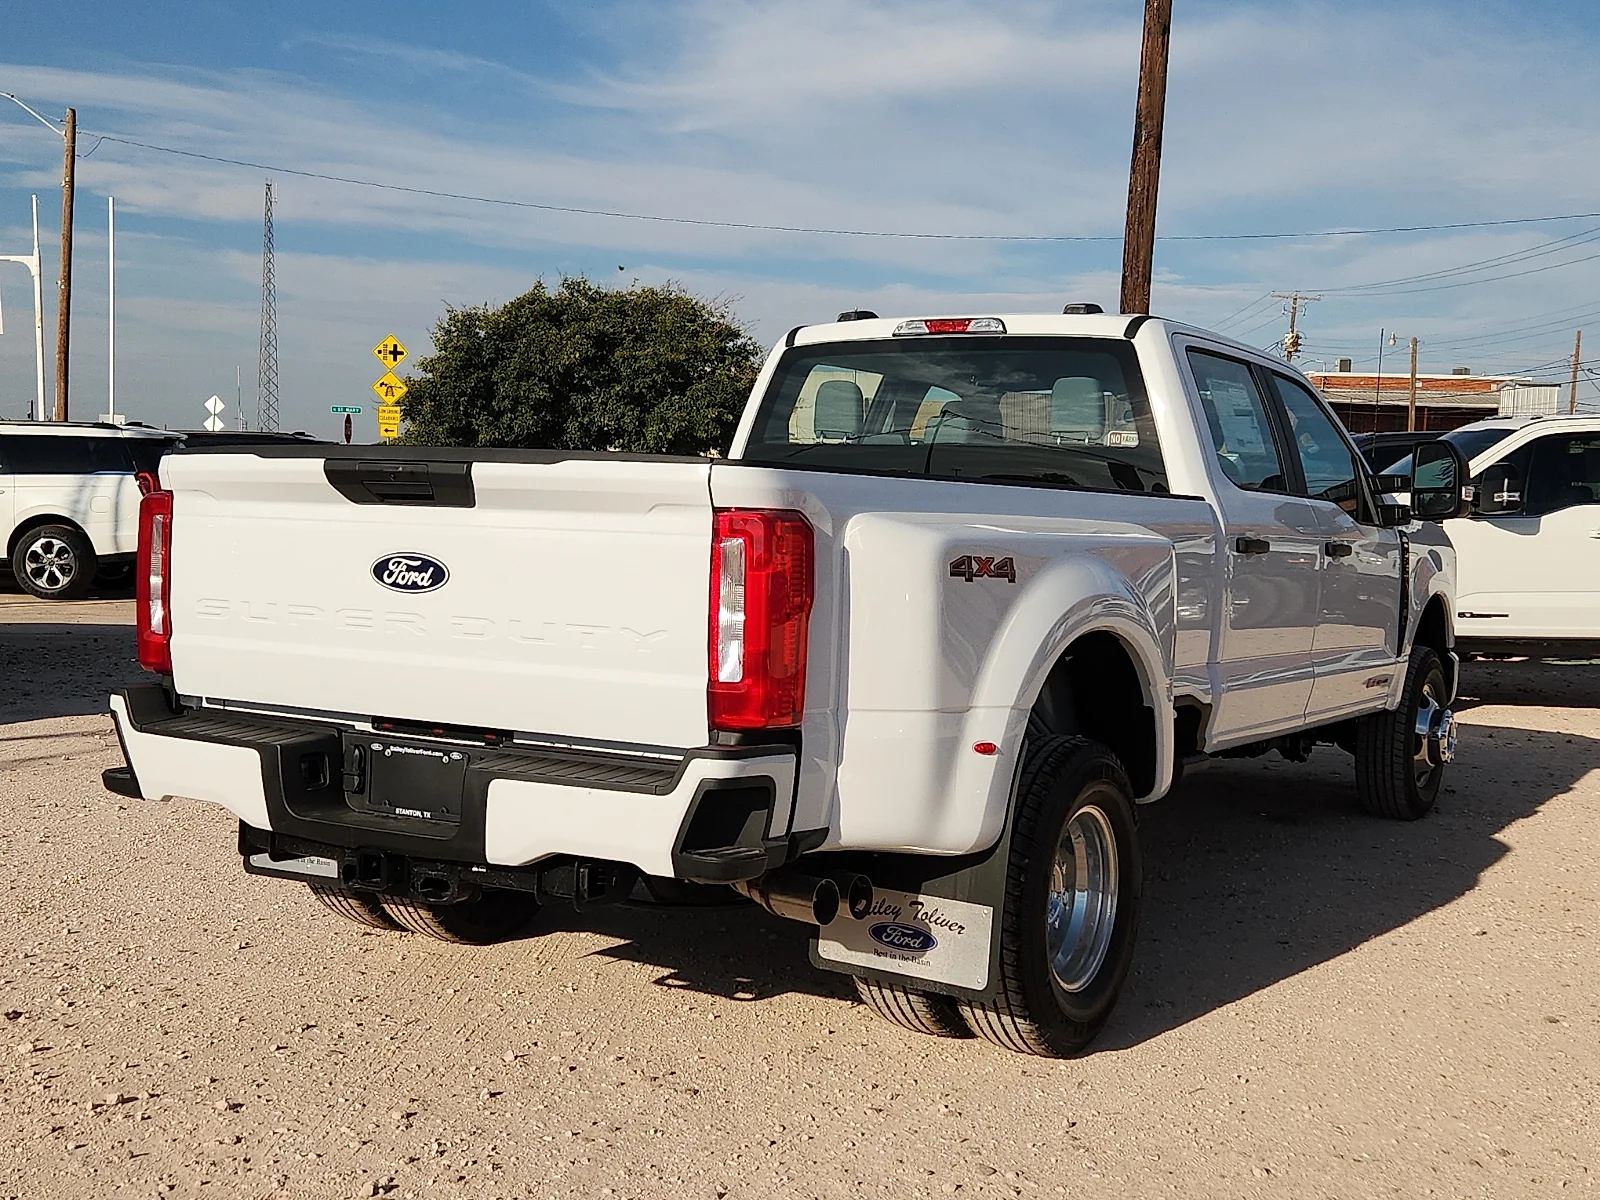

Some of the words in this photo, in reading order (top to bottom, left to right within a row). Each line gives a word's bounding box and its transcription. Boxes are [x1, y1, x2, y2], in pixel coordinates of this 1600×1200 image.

[1110, 434, 1120, 444] NO
[382, 557, 435, 587] Ford
[195, 597, 427, 637] SUPER
[450, 614, 669, 654] DUTY
[395, 807, 423, 818] STANTON,
[423, 811, 432, 819] TX
[908, 900, 966, 935] Toliver
[881, 925, 925, 948] Ford
[889, 951, 897, 960] in
[898, 953, 909, 962] the
